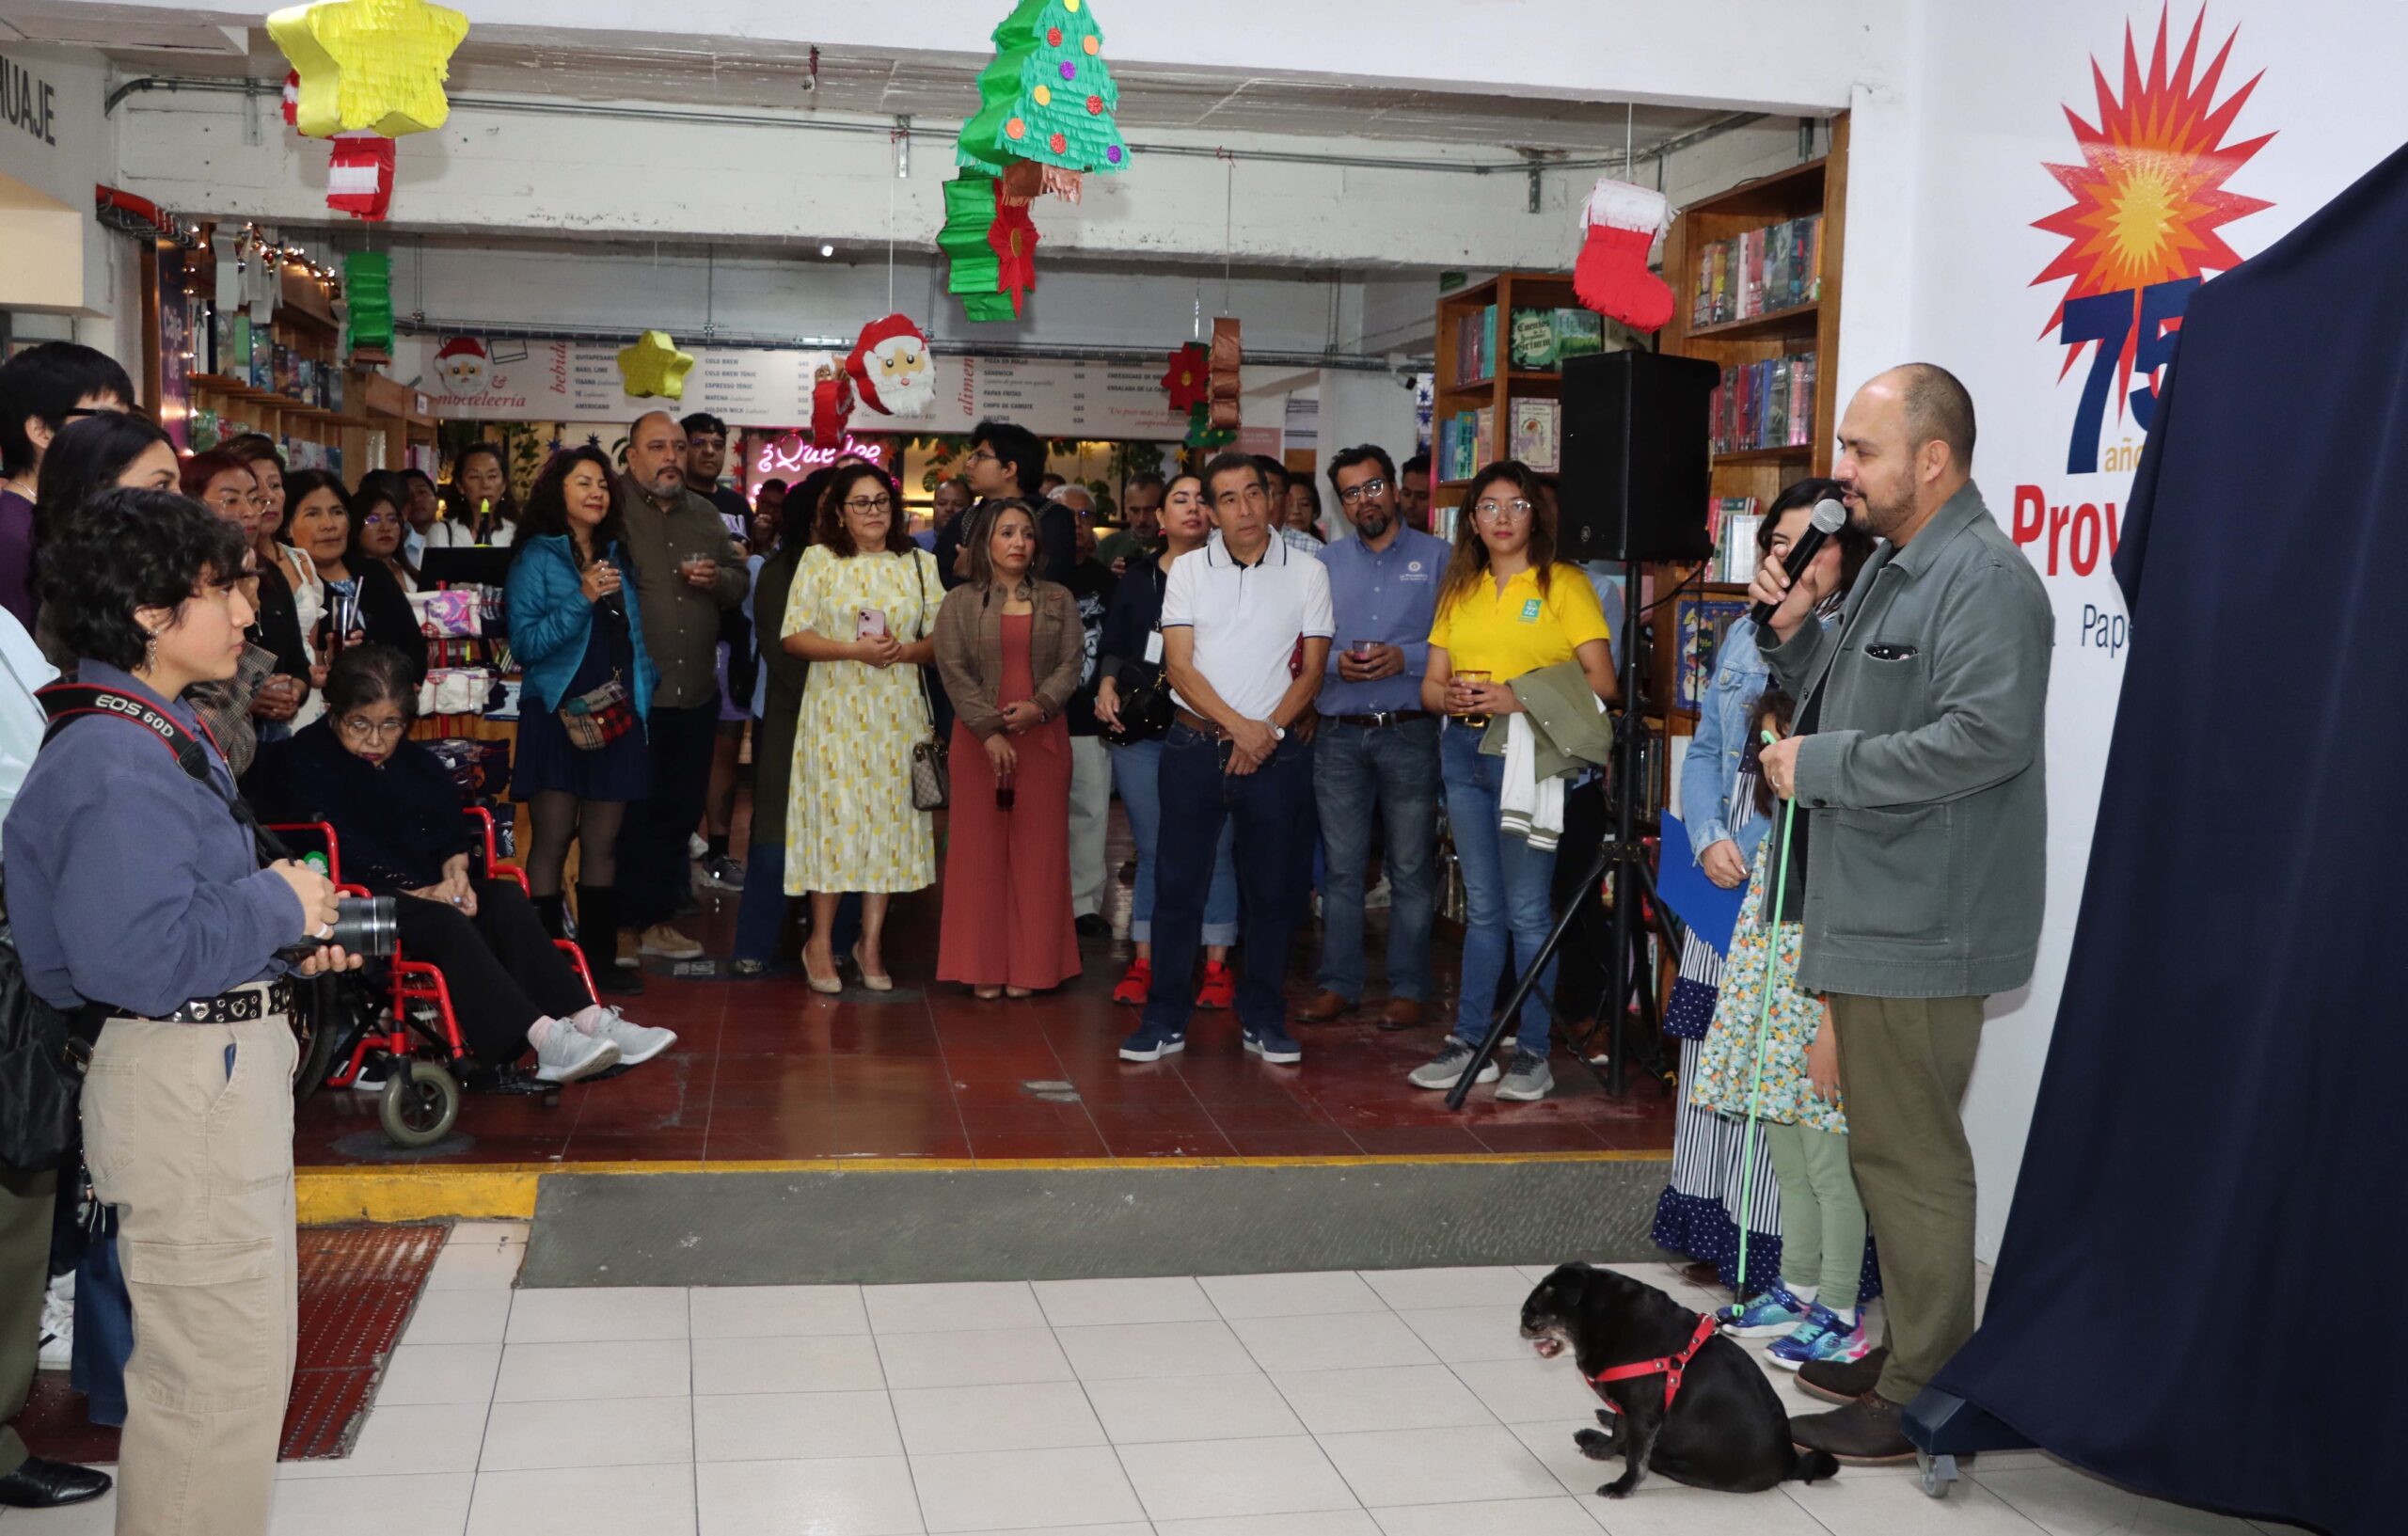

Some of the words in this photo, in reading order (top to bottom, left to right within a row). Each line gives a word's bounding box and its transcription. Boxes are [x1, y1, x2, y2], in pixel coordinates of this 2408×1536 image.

[2061, 277, 2201, 473] 75
[2082, 604, 2132, 658] Pap
[95, 694, 143, 716] EOS
[143, 711, 174, 737] 60D
